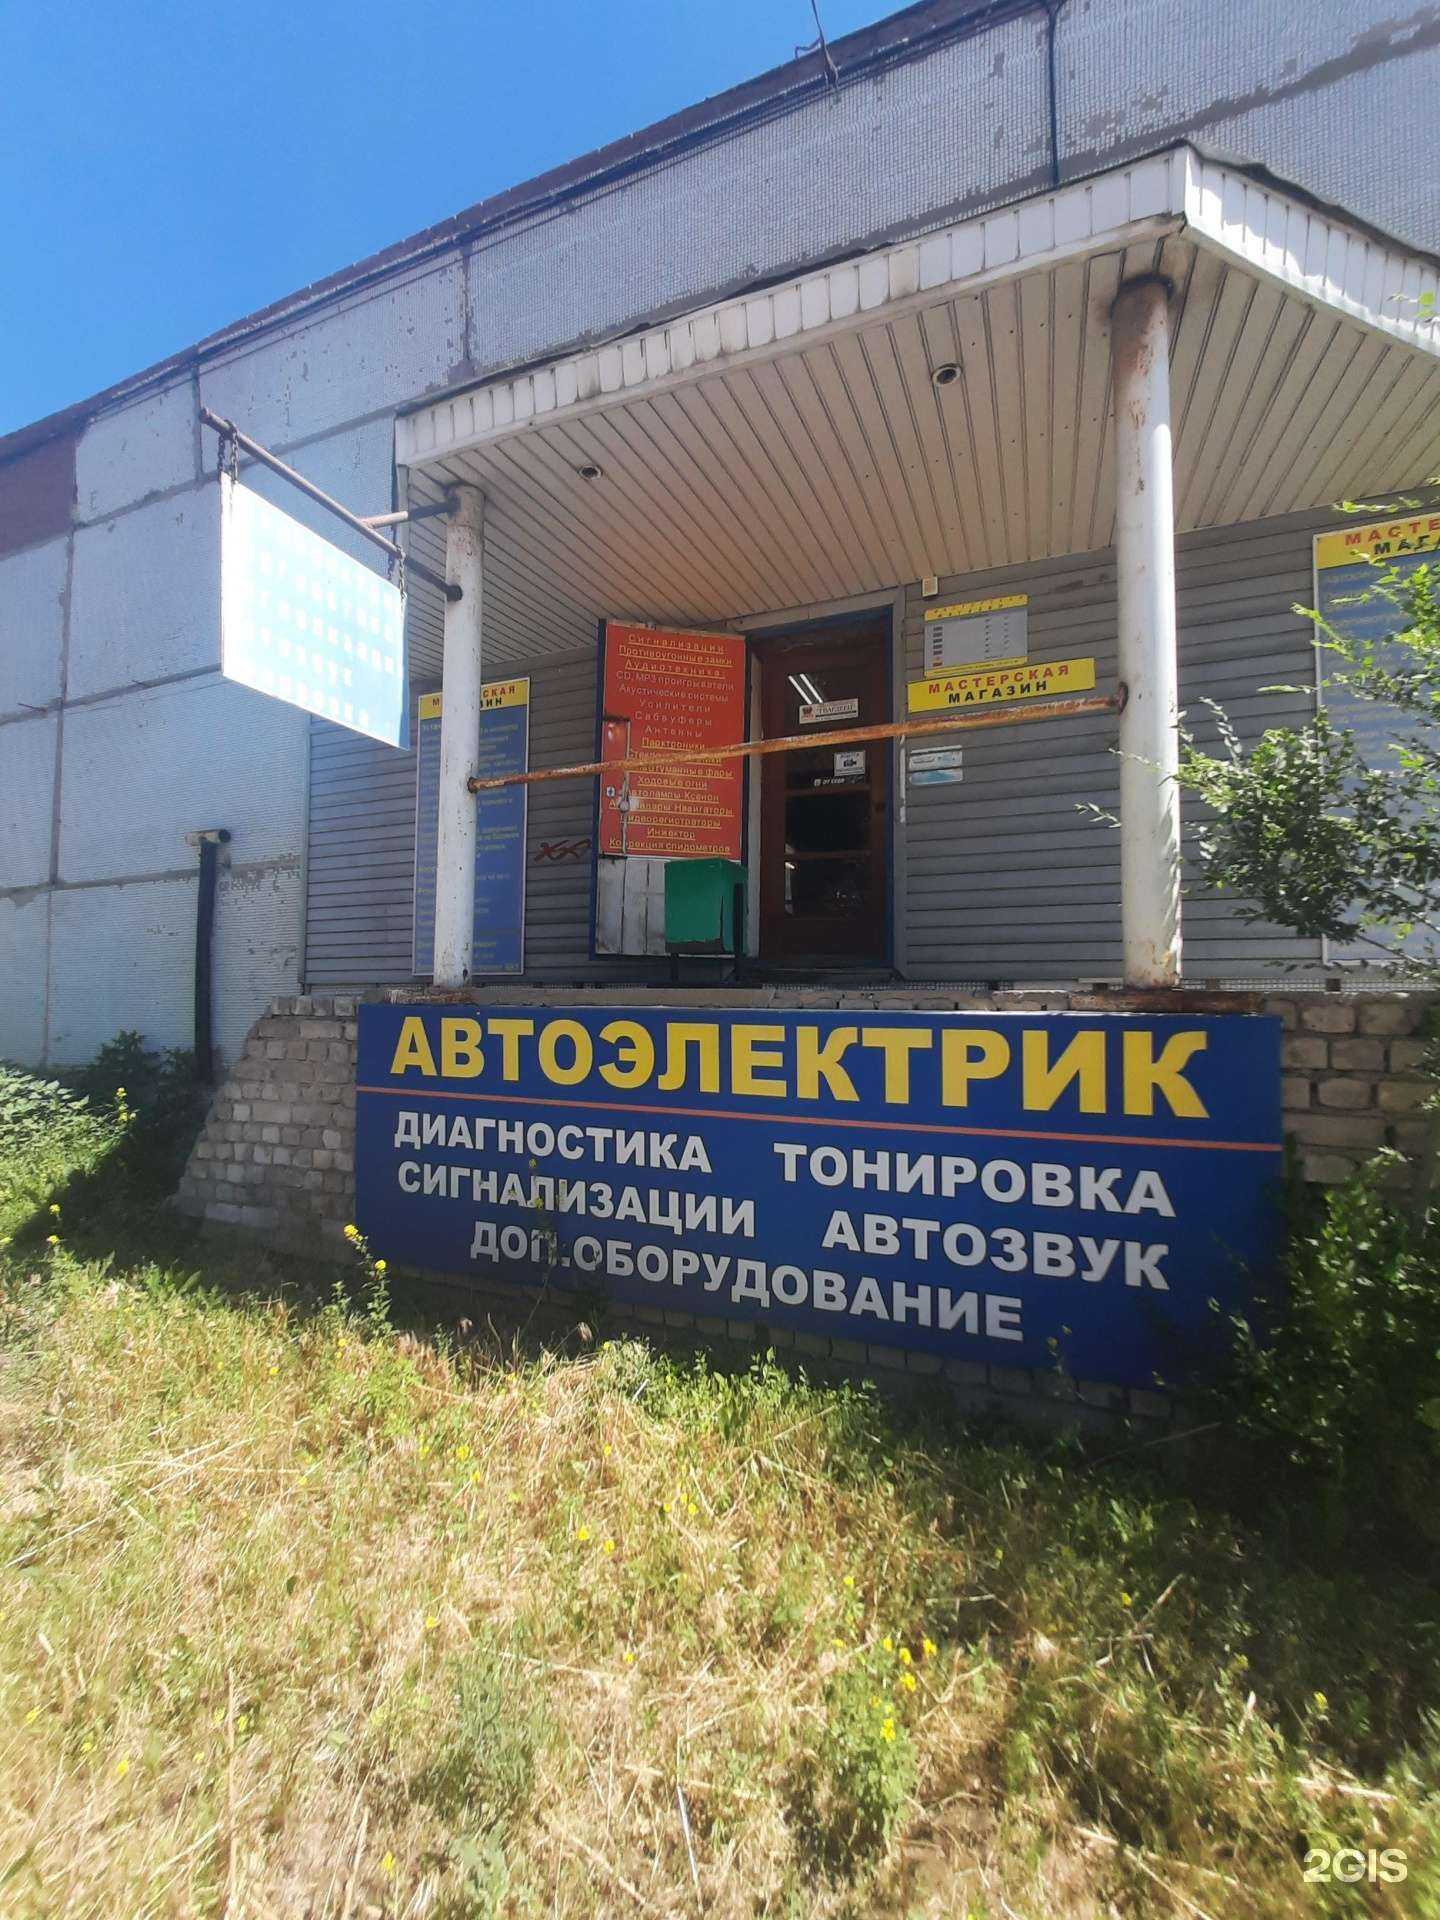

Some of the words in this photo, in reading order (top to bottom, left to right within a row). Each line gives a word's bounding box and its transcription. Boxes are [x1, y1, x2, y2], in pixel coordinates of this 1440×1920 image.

[618, 644, 704, 664] Противоугонные
[657, 676, 734, 691] проигрыватели
[928, 665, 1070, 695] МАСТЕРСКАЯ
[619, 683, 685, 698] Акустические
[687, 692, 729, 703] системы
[948, 681, 1048, 705] МАГАЗИН
[639, 698, 711, 713] Усилители
[635, 711, 712, 727] Сабвуферы
[645, 725, 702, 738] Антенны
[638, 775, 683, 787] Ходовые
[684, 779, 708, 789] огни
[684, 789, 719, 801] Ксенон
[674, 804, 734, 816] Навигаторы
[647, 827, 696, 840] Инжектор
[665, 842, 731, 853] спидометров
[389, 1015, 1210, 1119] АВТОЭЛЕКТРИК
[393, 1110, 713, 1174] ДИАГНОСТИКА
[772, 1142, 1177, 1218] ТОНИРОВКА
[397, 1160, 756, 1238] СИГНАЛИЗАЦИИ
[820, 1209, 1171, 1291] АВТОЗВУК
